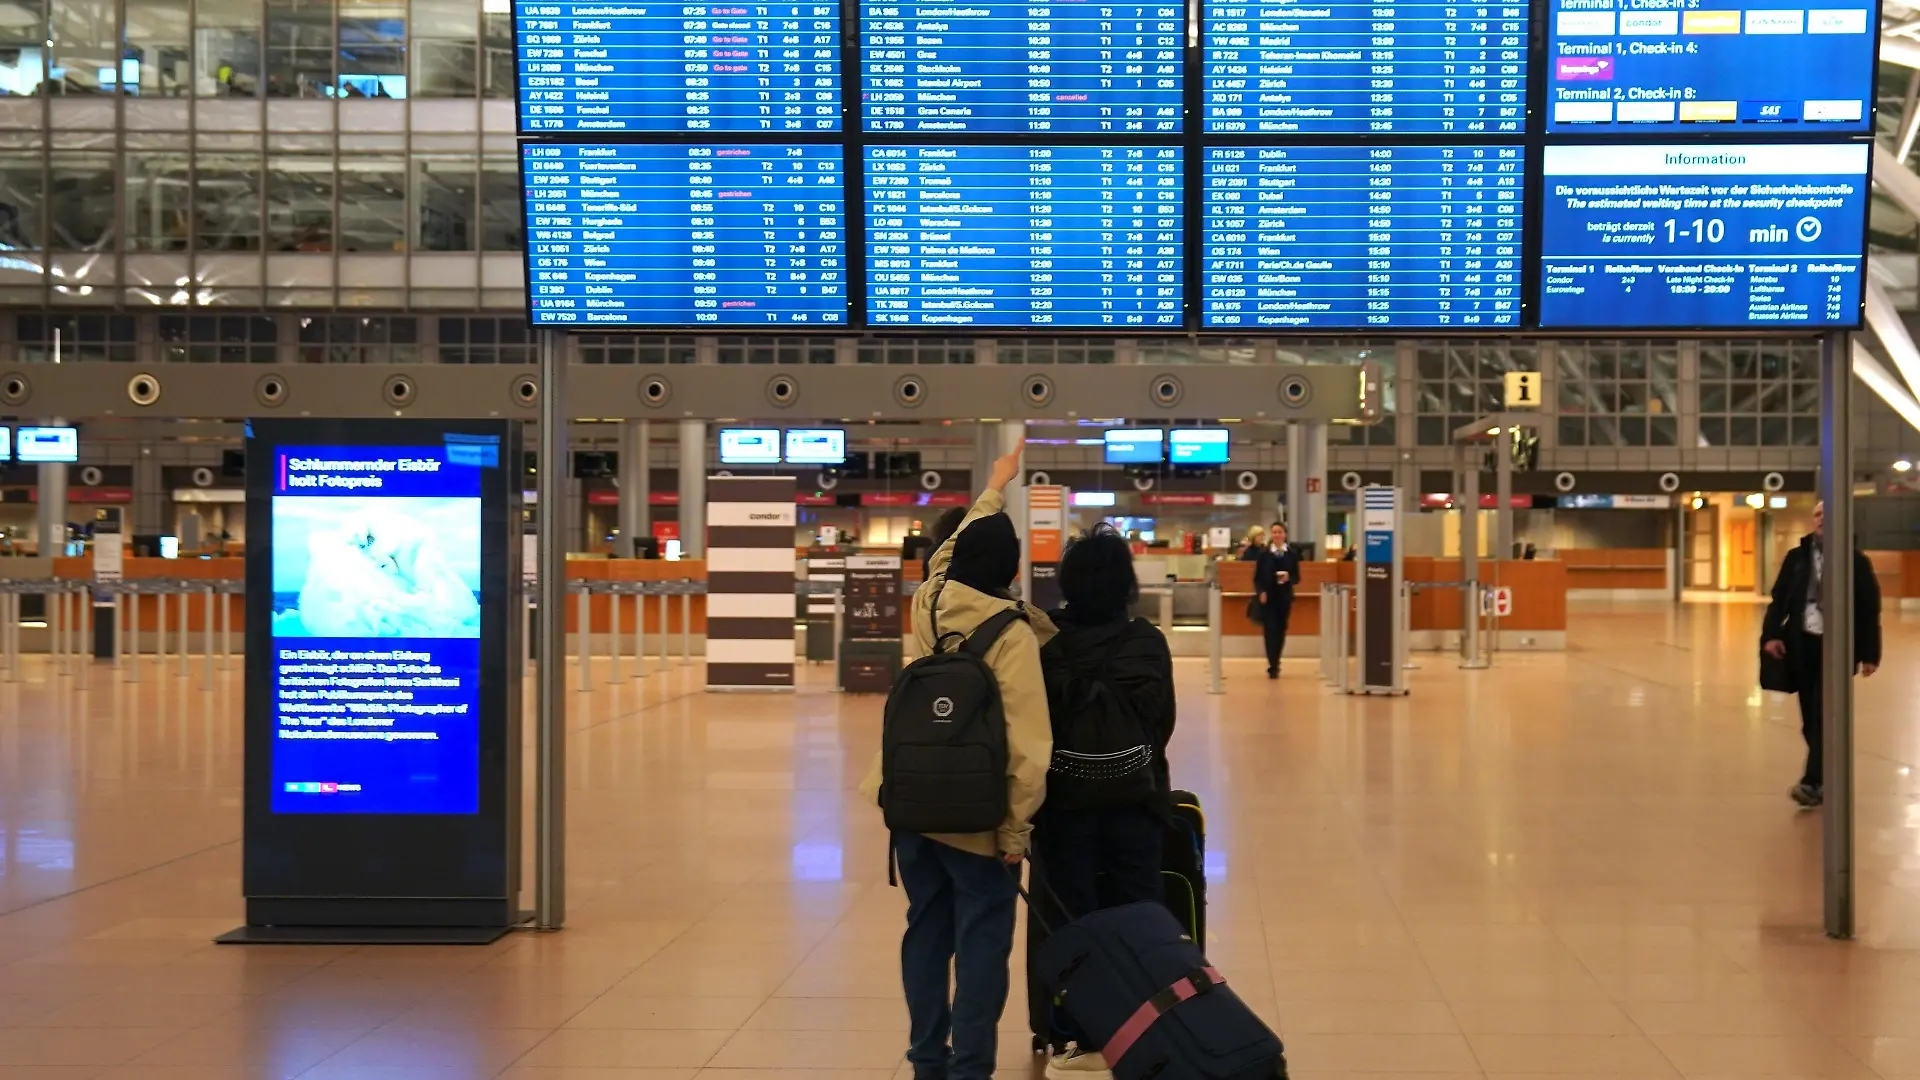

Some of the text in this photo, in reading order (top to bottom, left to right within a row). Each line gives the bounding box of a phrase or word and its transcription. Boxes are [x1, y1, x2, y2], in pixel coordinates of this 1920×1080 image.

[1561, 0, 1699, 10] Terminal 1, Check-in 3:
[756, 7, 767, 15] T1
[574, 35, 600, 43] Zürich
[1558, 42, 1698, 55] Terminal 1, Check-in 4:
[951, 79, 981, 88] Airport
[1101, 79, 1111, 87] T1
[1556, 87, 1696, 100] Terminal 2, Check-in 8:
[1260, 108, 1484, 116] London/Heathrow 7
[1760, 105, 1782, 116] SAS
[531, 120, 770, 128] KL Amsterdam T1
[532, 148, 544, 156] LH
[579, 148, 616, 156] Frankfurt
[1212, 150, 1223, 158] FR
[1259, 150, 1286, 158] Dublin
[1370, 150, 1392, 158] 14:00
[1442, 150, 1453, 158] T2
[1666, 153, 1745, 164] Information
[762, 162, 772, 170] T2
[818, 162, 834, 170] C13
[1259, 164, 1296, 172] Frankfurt
[1370, 164, 1391, 172] 14:00
[1442, 164, 1453, 172] T2
[1498, 163, 1515, 171] A17
[534, 190, 546, 198] LH
[1556, 186, 1573, 195] Die
[1576, 185, 1660, 195] voraussichtliche
[1659, 185, 1709, 195] Wartezeit
[1730, 185, 1748, 194] der
[1750, 184, 1853, 194] Sicherheitskontrolle
[1567, 197, 1843, 209] The estimated waiting time at the security checkpoint
[1588, 222, 1654, 232] beträgt derzeit
[1665, 219, 1788, 243] 1-10 min
[1602, 234, 1655, 244] is currently
[584, 245, 610, 253] Zürich
[764, 245, 775, 253] T2
[790, 245, 805, 253] 7+8
[820, 245, 836, 253] A17
[1258, 247, 1280, 255] Wien
[1546, 265, 1586, 273] Terminal
[1589, 265, 1594, 273] 1
[1749, 264, 1789, 272] Terminal
[1791, 264, 1797, 272] 2
[1683, 276, 1702, 284] Night
[1547, 286, 1584, 294] Eurowings
[587, 313, 627, 321] Barcelona
[922, 314, 973, 323] Kopenhagen
[1258, 316, 1309, 325] Kopenhagen
[1439, 315, 1450, 323] T2
[289, 458, 441, 471] Schlummernder Eisbär
[289, 475, 382, 489] holt Fotopreis
